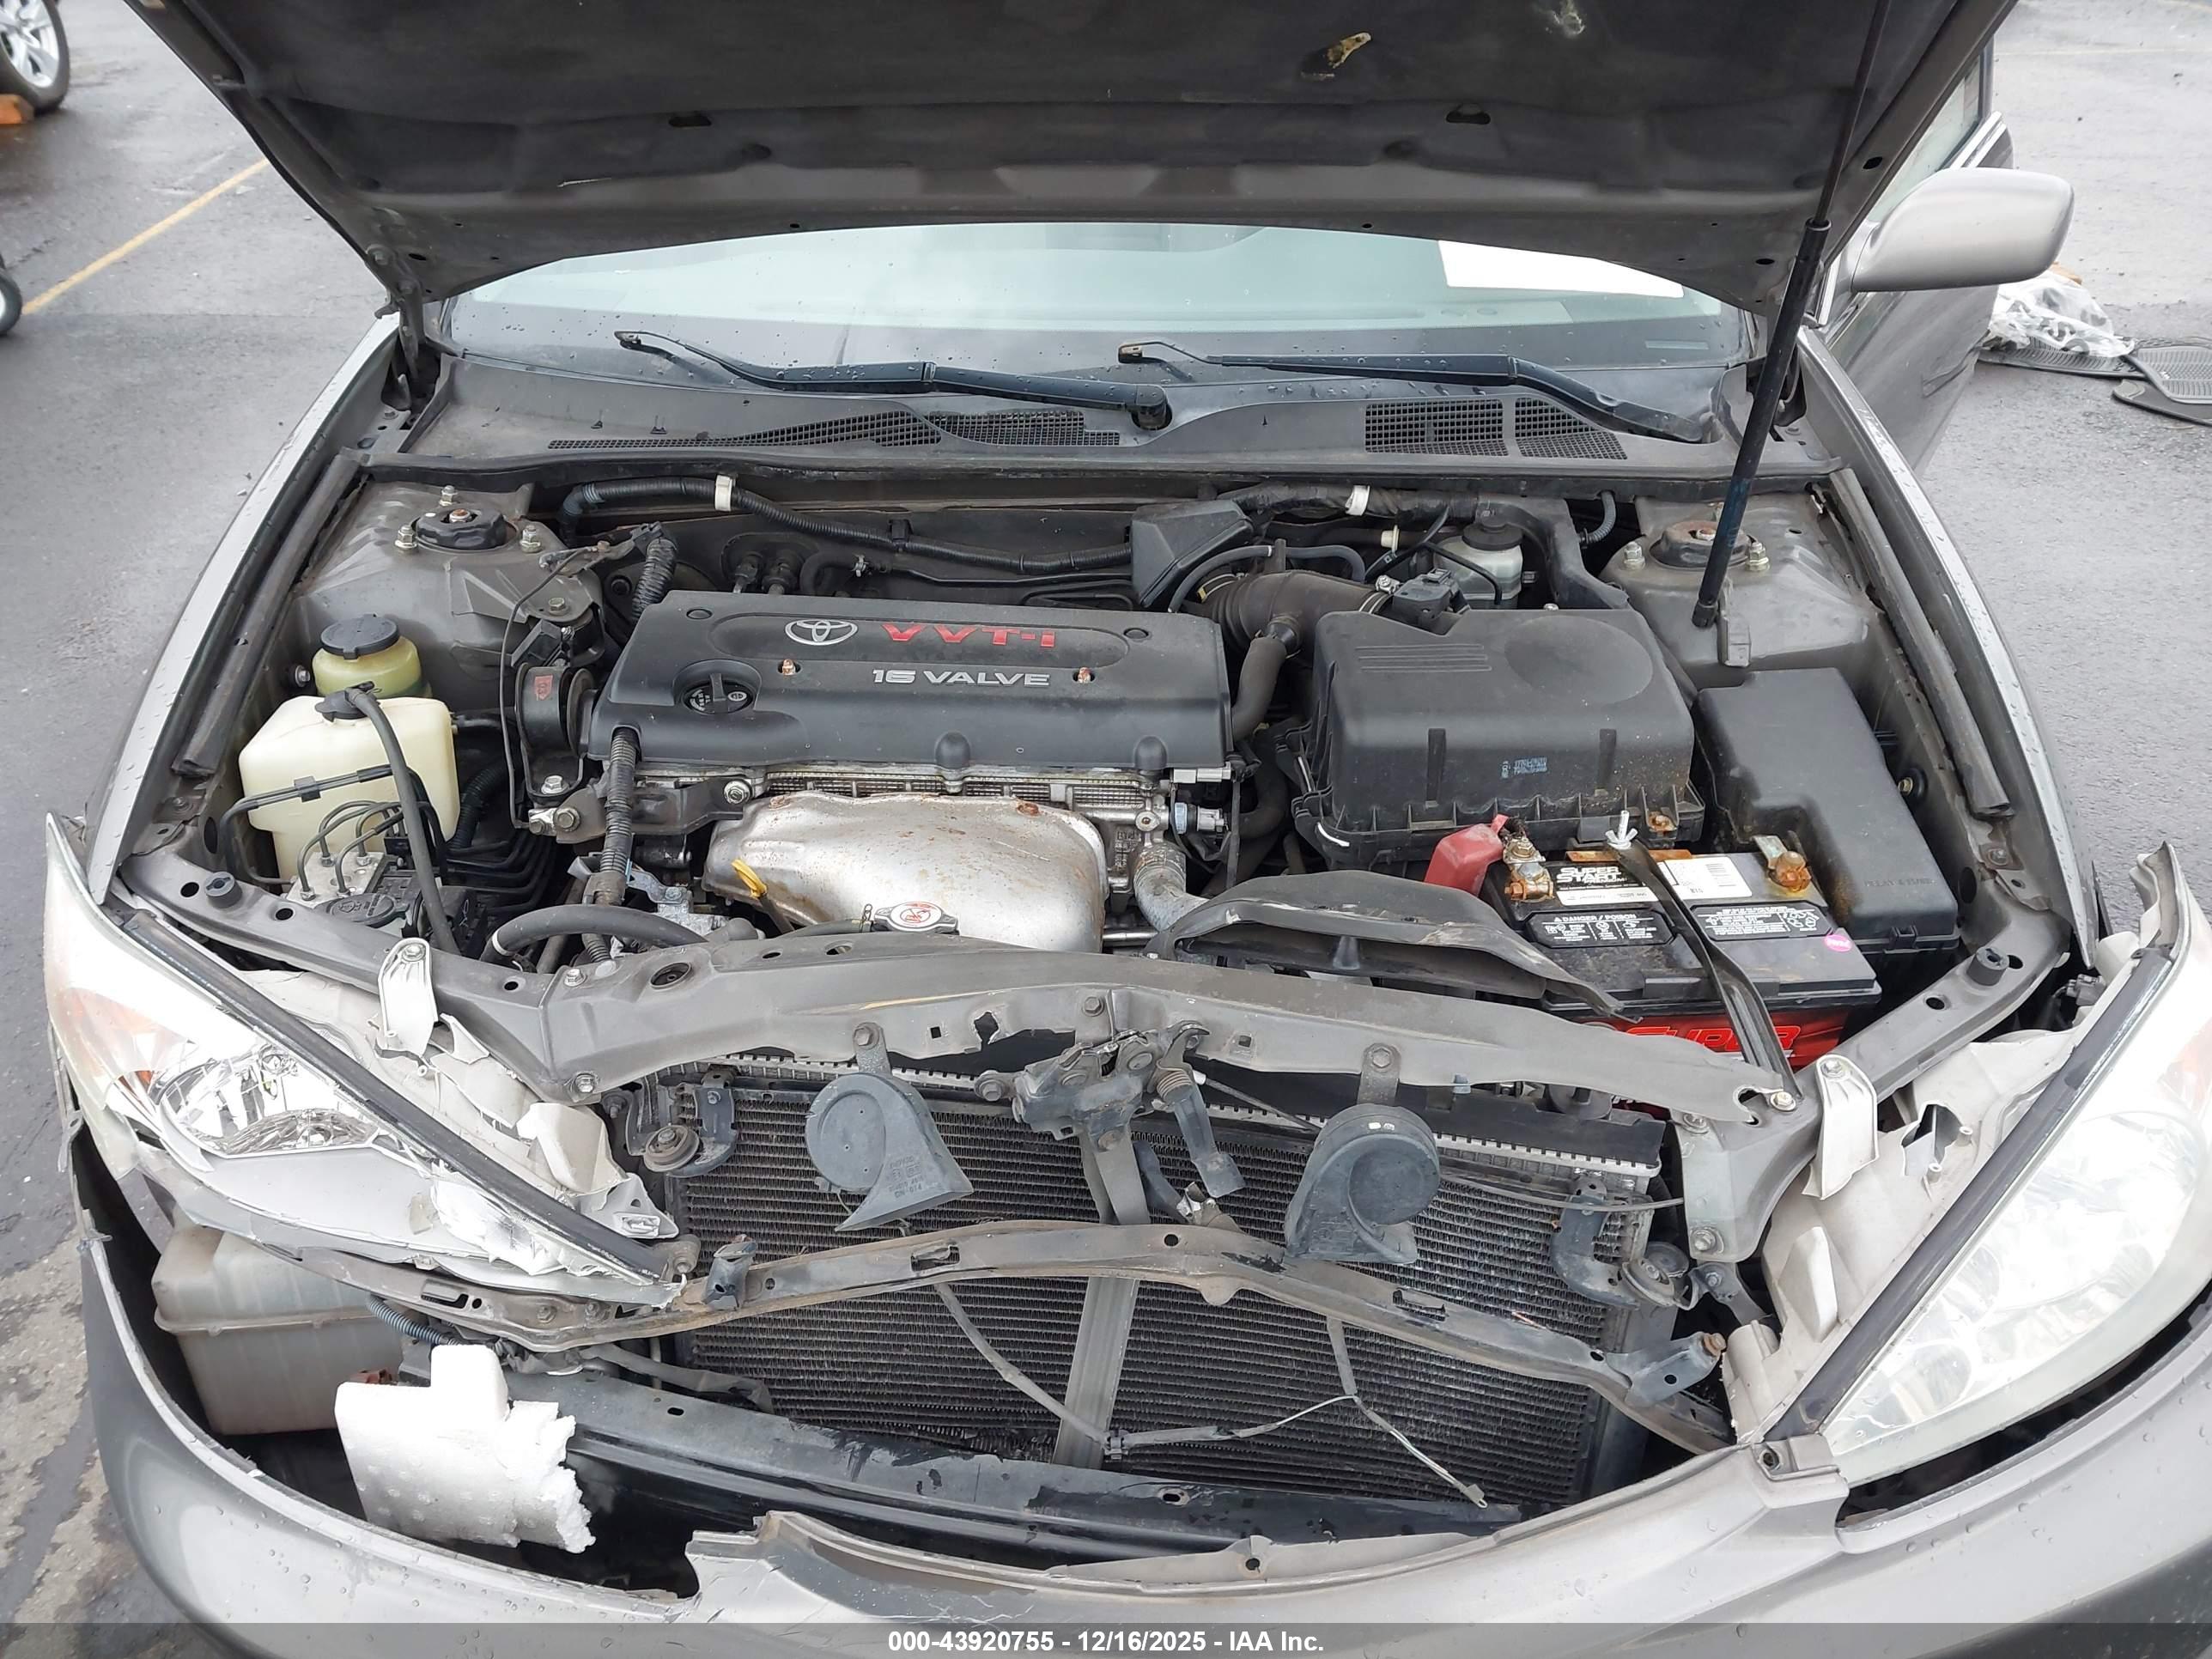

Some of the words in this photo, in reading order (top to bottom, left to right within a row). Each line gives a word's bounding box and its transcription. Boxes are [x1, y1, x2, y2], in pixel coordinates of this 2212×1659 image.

[872, 669, 916, 684] 16
[923, 670, 1050, 686] VALVE
[1560, 866, 1620, 875] SUPER
[1556, 872, 1621, 884] START
